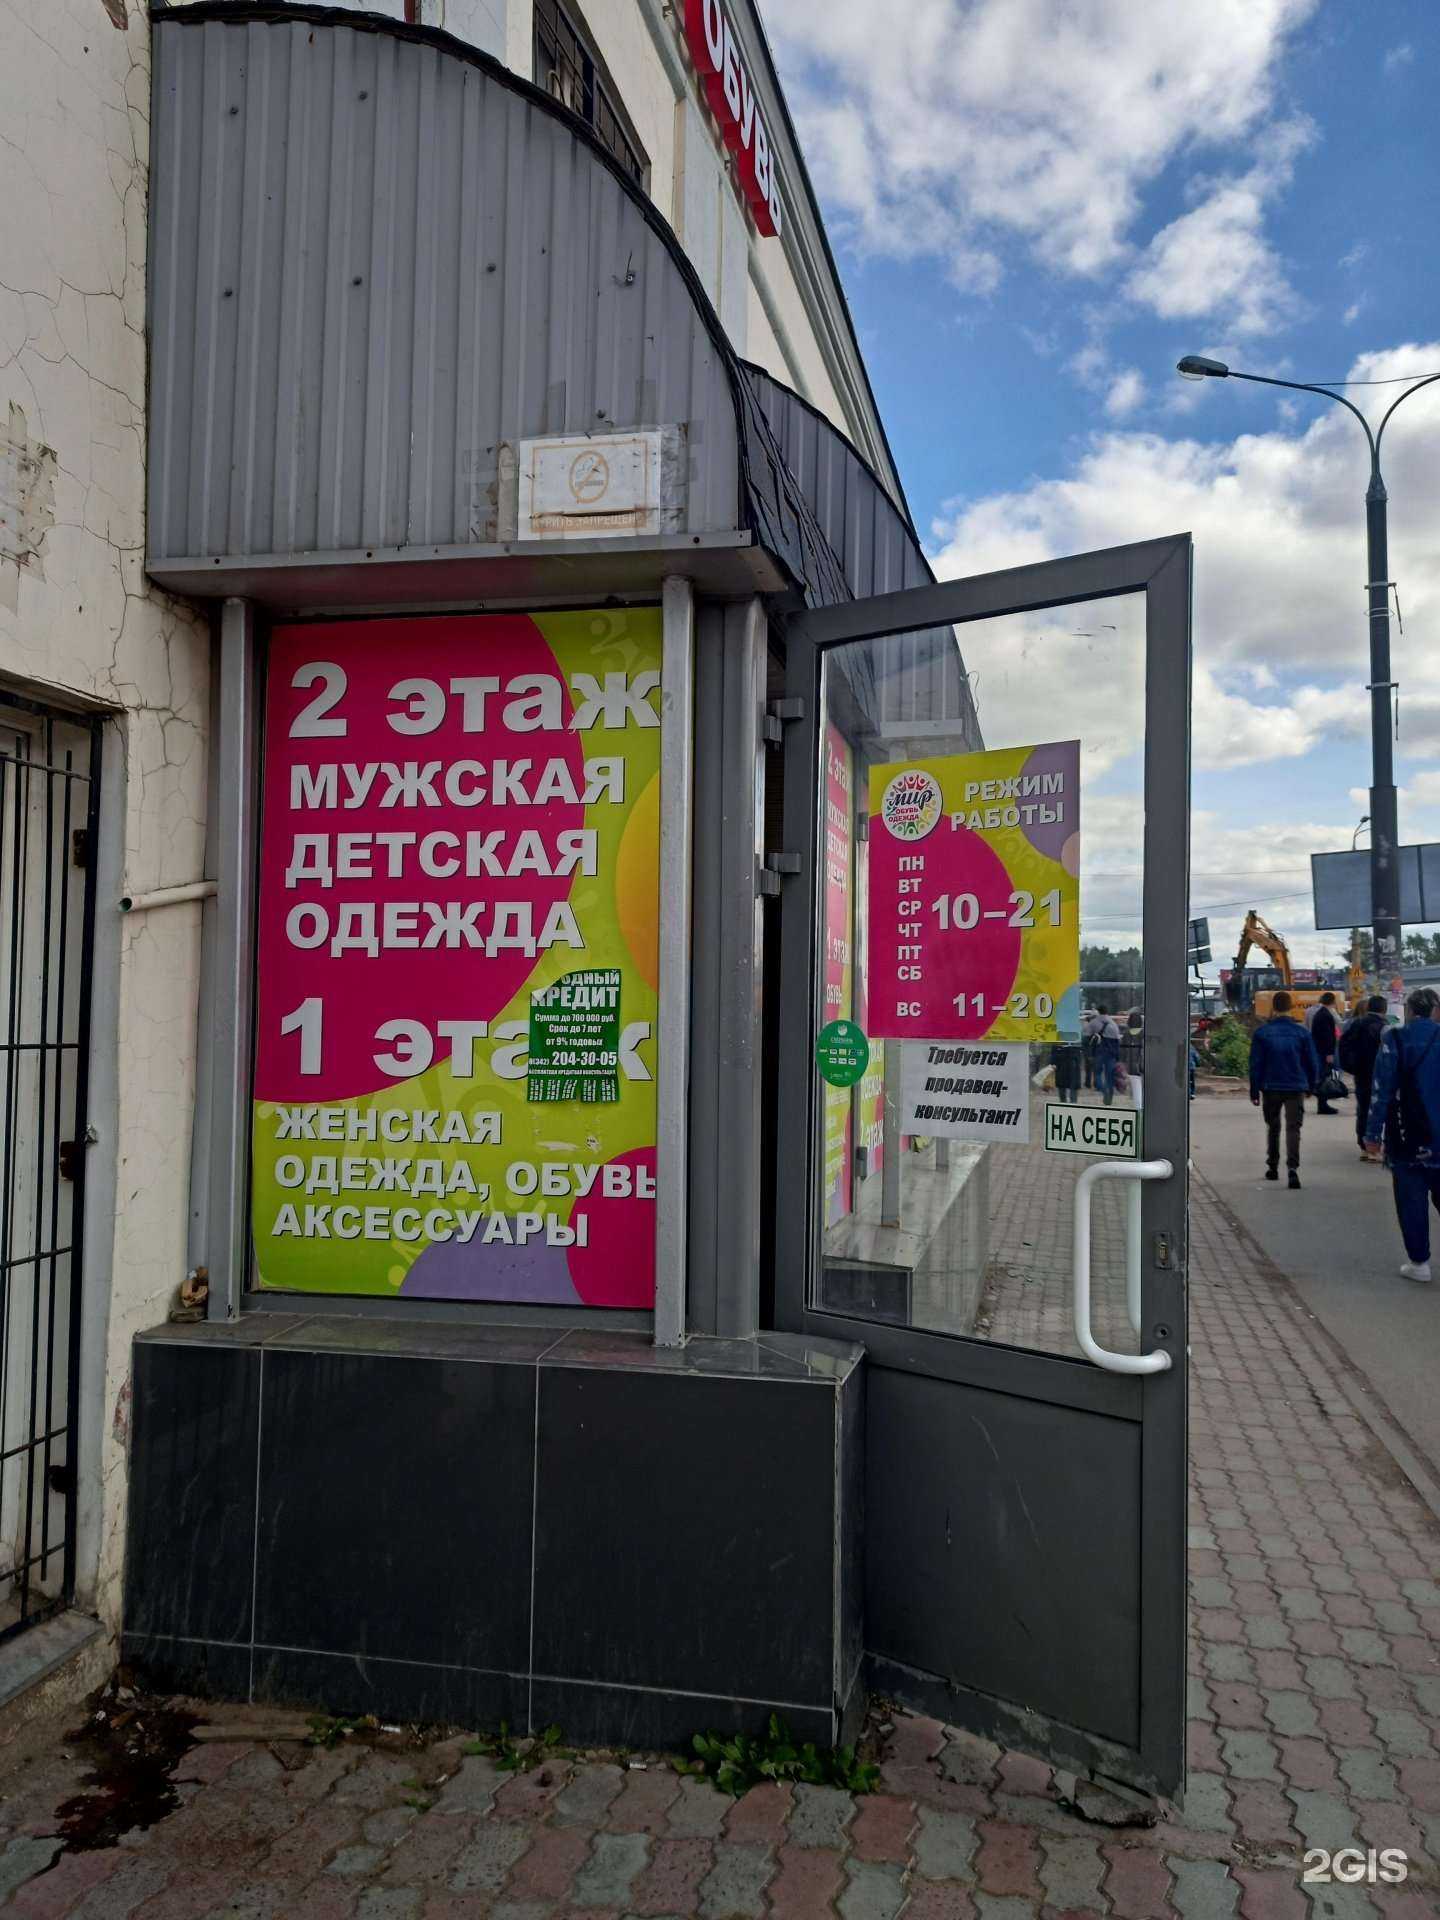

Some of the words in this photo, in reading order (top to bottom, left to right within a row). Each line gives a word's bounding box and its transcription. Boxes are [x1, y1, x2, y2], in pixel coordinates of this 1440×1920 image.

[289, 661, 348, 738] 2
[386, 670, 660, 735] этаж
[289, 756, 625, 810] МУЖСКАЯ
[964, 772, 1064, 802] РЕЖИМ
[951, 801, 1064, 831] РАБОТЫ
[285, 829, 598, 888] ДЕТСКАЯ
[898, 855, 925, 872] ПН
[898, 878, 922, 893] ВТ
[898, 901, 922, 917] СР
[286, 901, 585, 958] ОДЕЖДА
[898, 923, 921, 939] ЧТ
[898, 945, 921, 960] ПТ
[897, 965, 922, 982] СБ
[896, 1002, 921, 1018] ВС
[280, 997, 323, 1075] 1
[552, 1051, 617, 1066] 204-30-05
[927, 1046, 1007, 1067] Требуется
[924, 1076, 1008, 1098] продавец-
[274, 1108, 503, 1145] ЖЕНСКАЯ
[914, 1103, 1022, 1127] консультант!
[1051, 1113, 1076, 1143] НА
[1081, 1116, 1134, 1148] СЕБЯ
[274, 1156, 490, 1202] ОДЕЖДА,
[271, 1204, 588, 1248] АКСЕССУАРЫ
